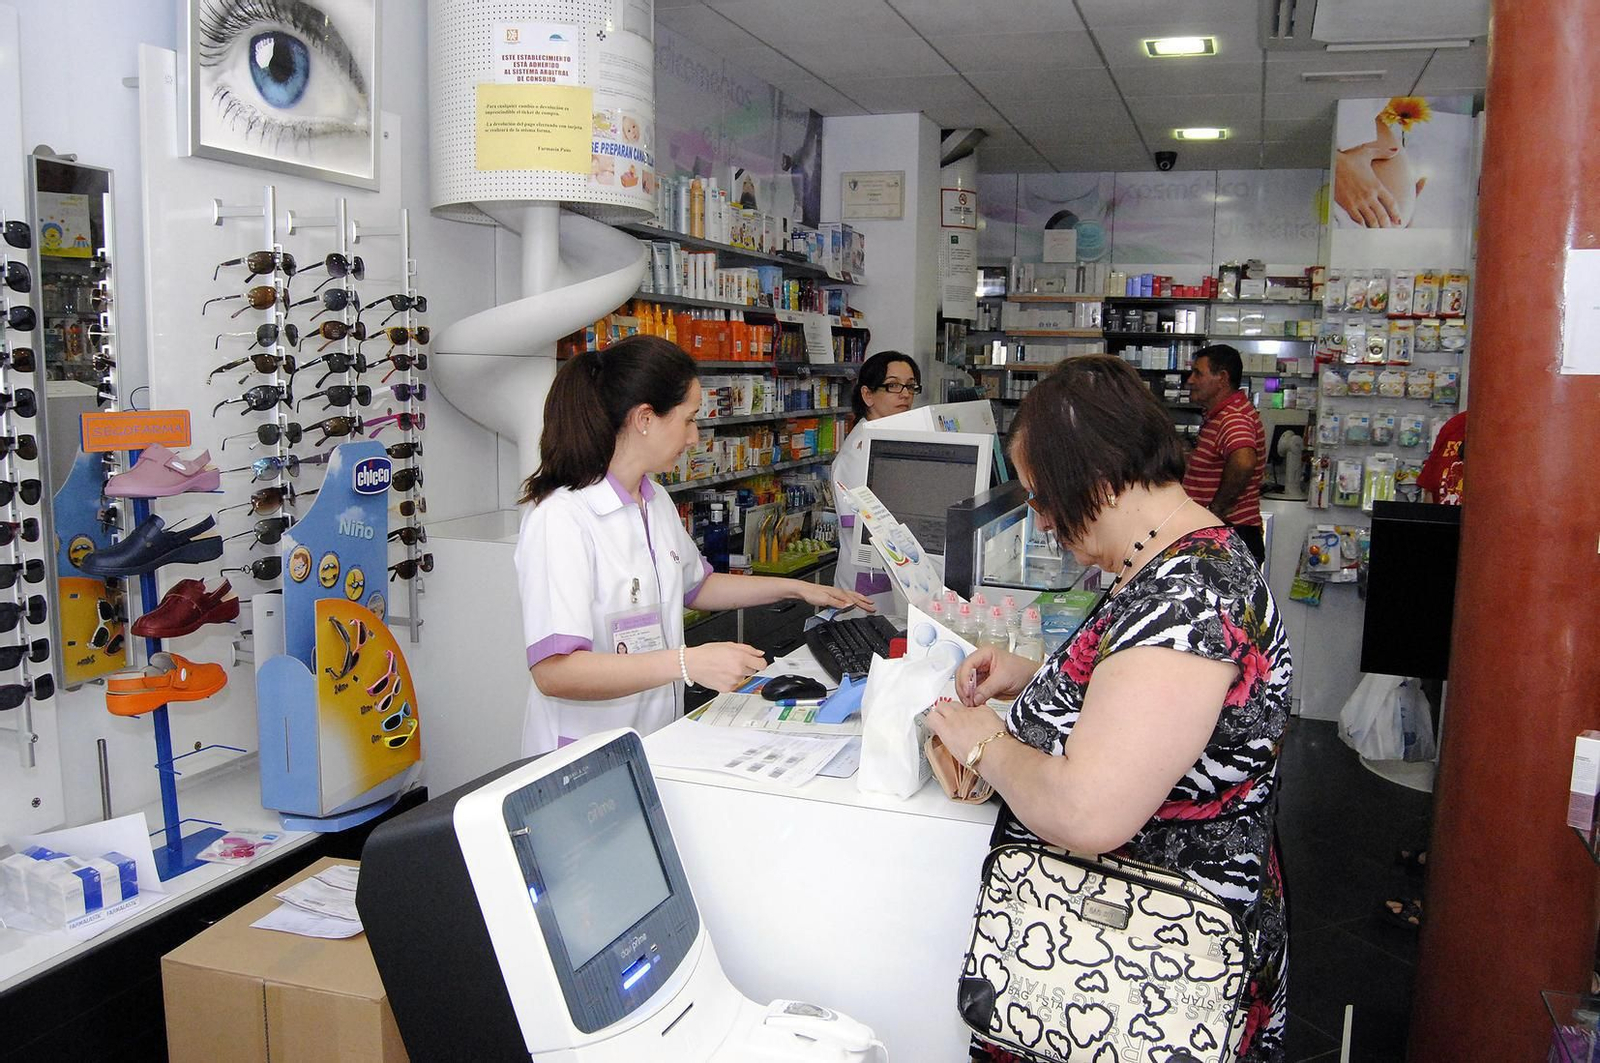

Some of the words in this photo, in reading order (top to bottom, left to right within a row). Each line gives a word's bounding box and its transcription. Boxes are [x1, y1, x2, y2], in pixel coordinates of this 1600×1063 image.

[517, 54, 571, 62] ESTABLECIMIENTO
[529, 61, 560, 69] ADHERIDO
[539, 69, 569, 77] ARBITRAL
[600, 141, 633, 160] PREPARAN
[339, 519, 374, 540] Niño
